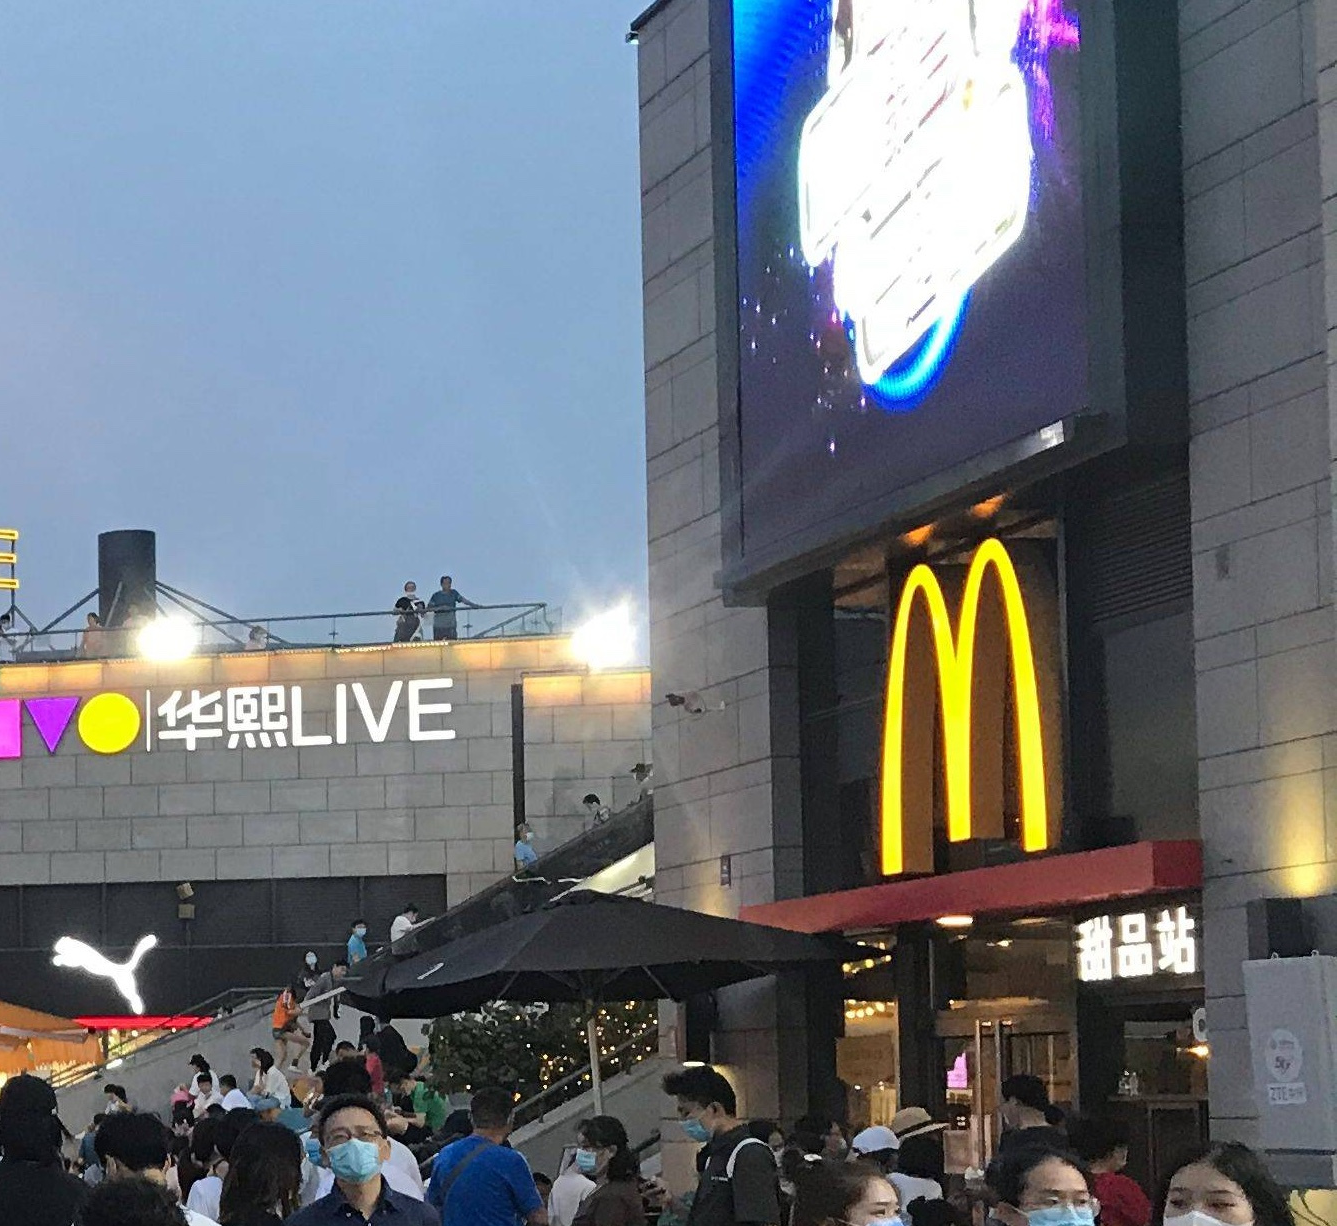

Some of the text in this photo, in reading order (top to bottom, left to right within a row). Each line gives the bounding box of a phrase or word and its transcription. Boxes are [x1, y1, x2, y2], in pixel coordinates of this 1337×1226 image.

[157, 678, 456, 751] 华熙LIVE
[1077, 905, 1196, 981] 甜品站
